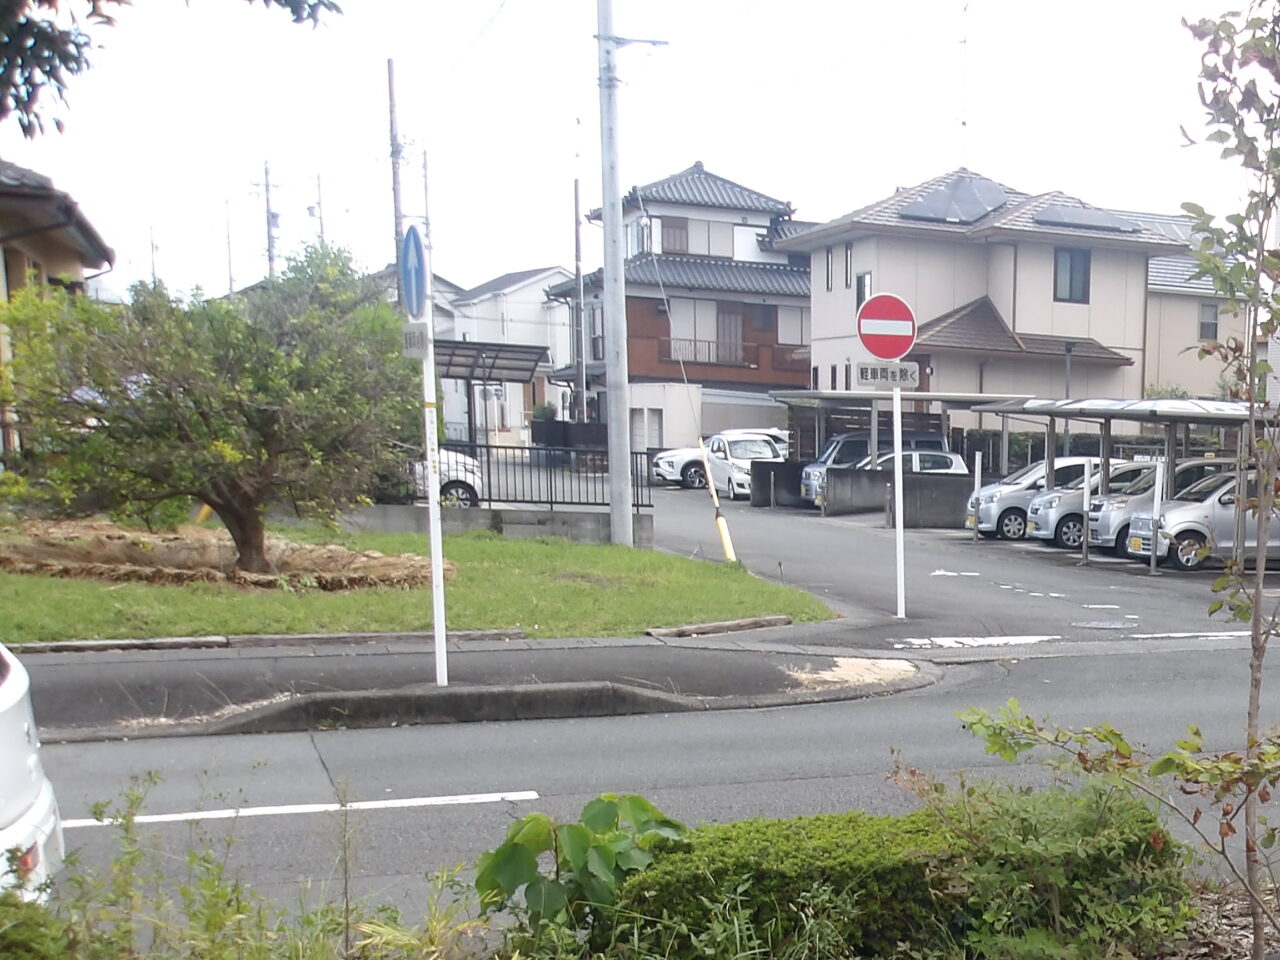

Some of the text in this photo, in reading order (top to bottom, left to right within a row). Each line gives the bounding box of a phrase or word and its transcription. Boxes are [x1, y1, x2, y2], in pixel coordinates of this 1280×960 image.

[860, 367, 917, 382] 軽車両を除く
